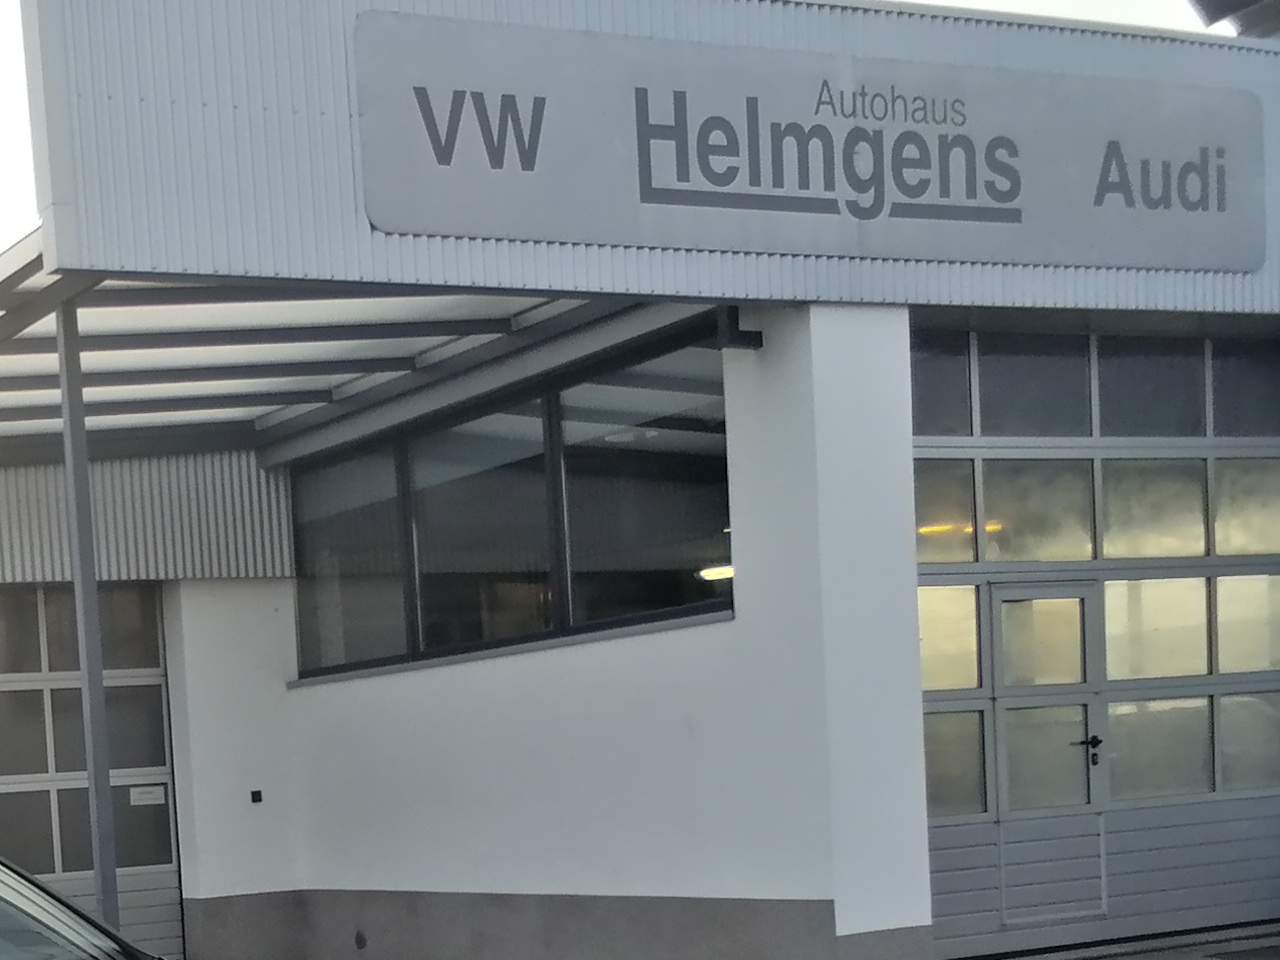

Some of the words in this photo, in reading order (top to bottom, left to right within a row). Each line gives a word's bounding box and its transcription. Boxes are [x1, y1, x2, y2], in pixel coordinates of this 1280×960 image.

[412, 86, 547, 173] VW
[815, 79, 967, 127] Autohaus
[634, 86, 1023, 222] Helmgens
[1093, 140, 1228, 213] Audi
